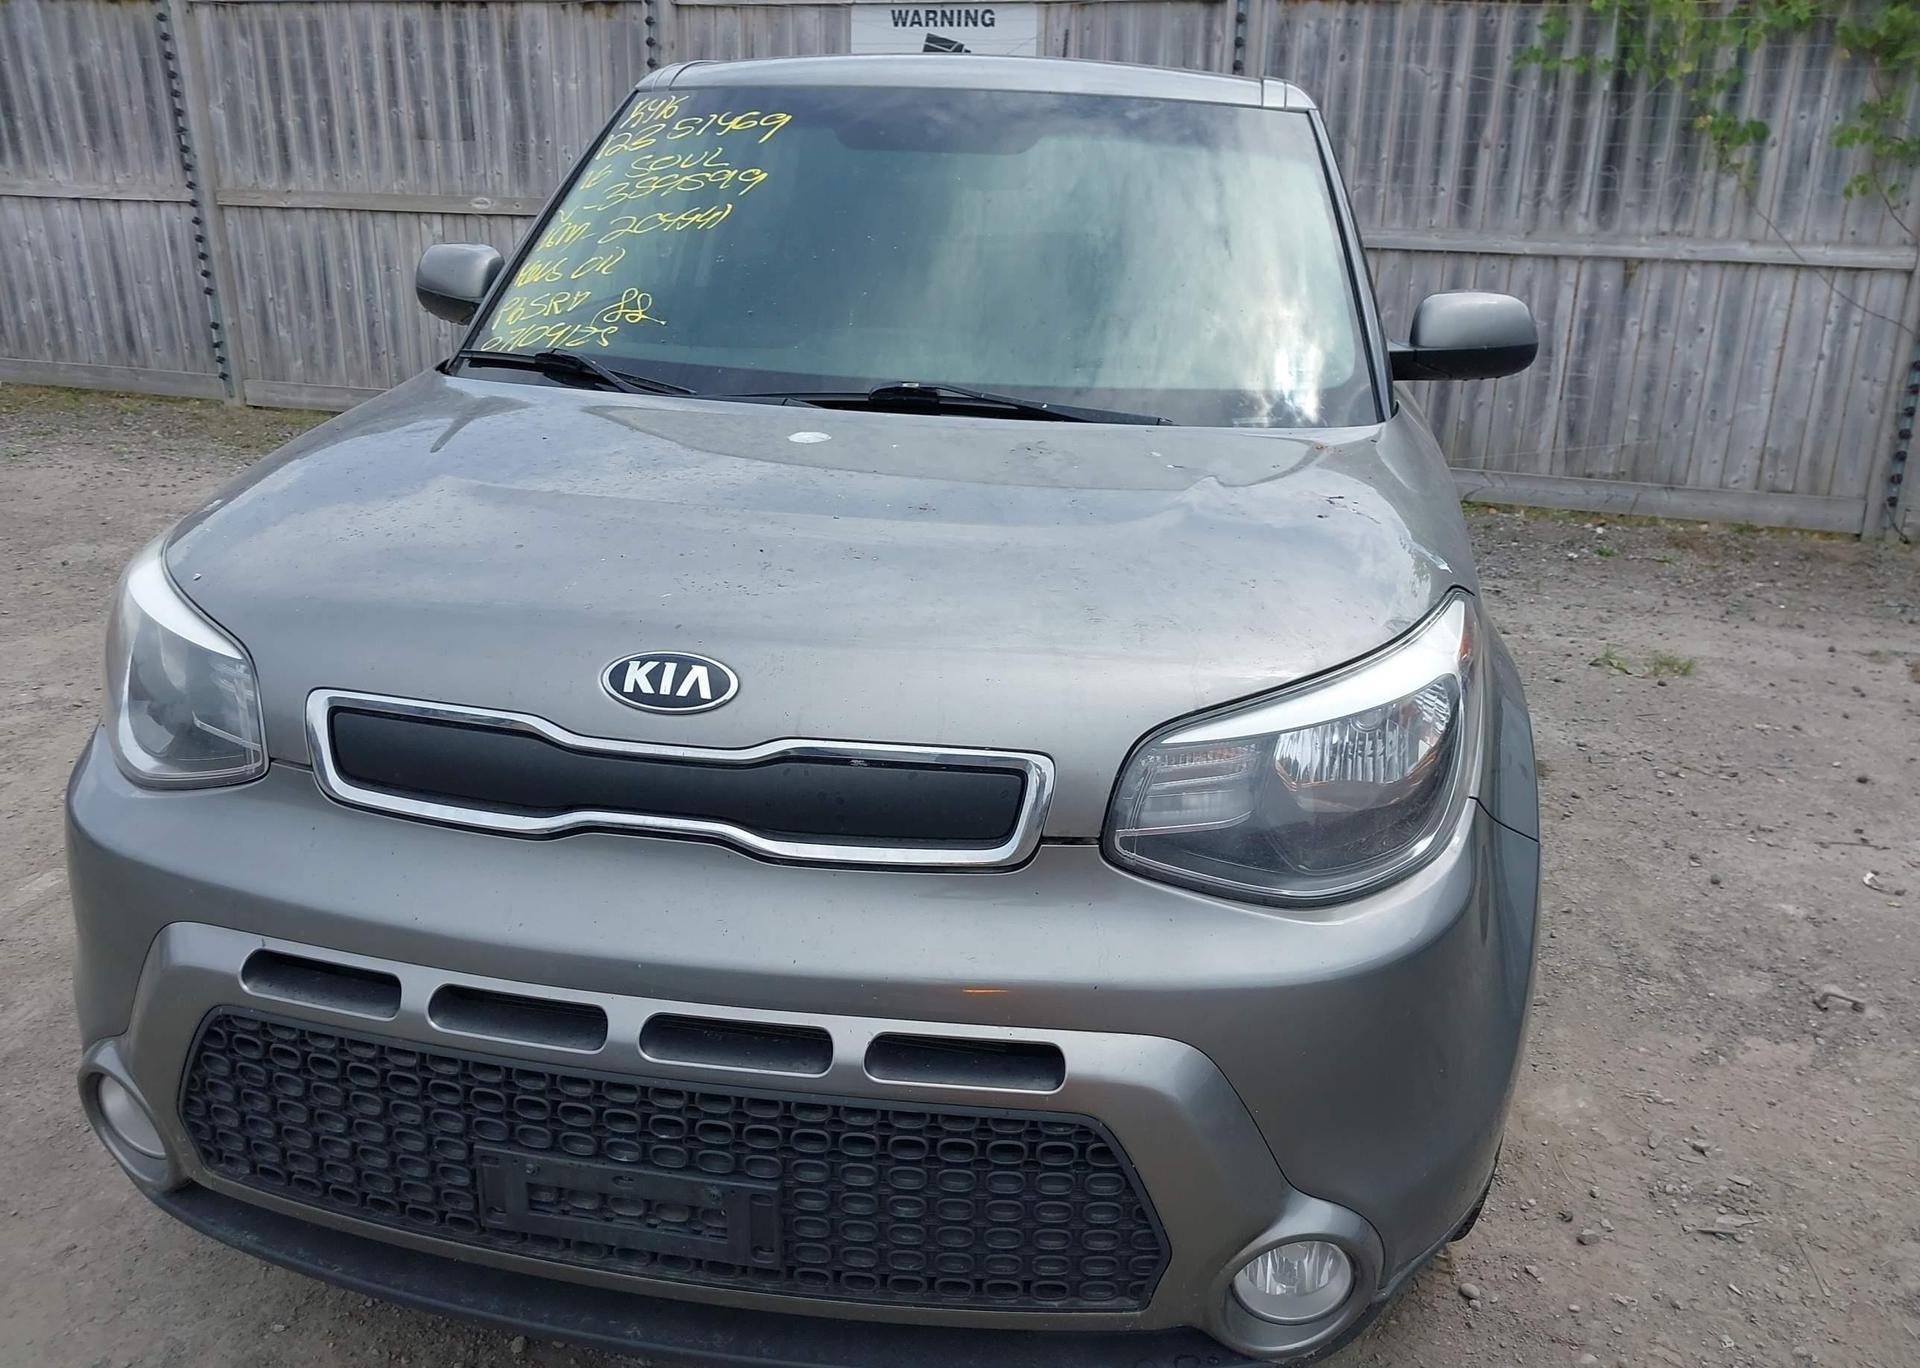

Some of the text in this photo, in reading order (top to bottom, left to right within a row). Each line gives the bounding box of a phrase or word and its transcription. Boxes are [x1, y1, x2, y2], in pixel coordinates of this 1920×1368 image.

[891, 9, 995, 27] WARNING
[625, 147, 730, 179] SOUL
[623, 660, 712, 700] KIA
